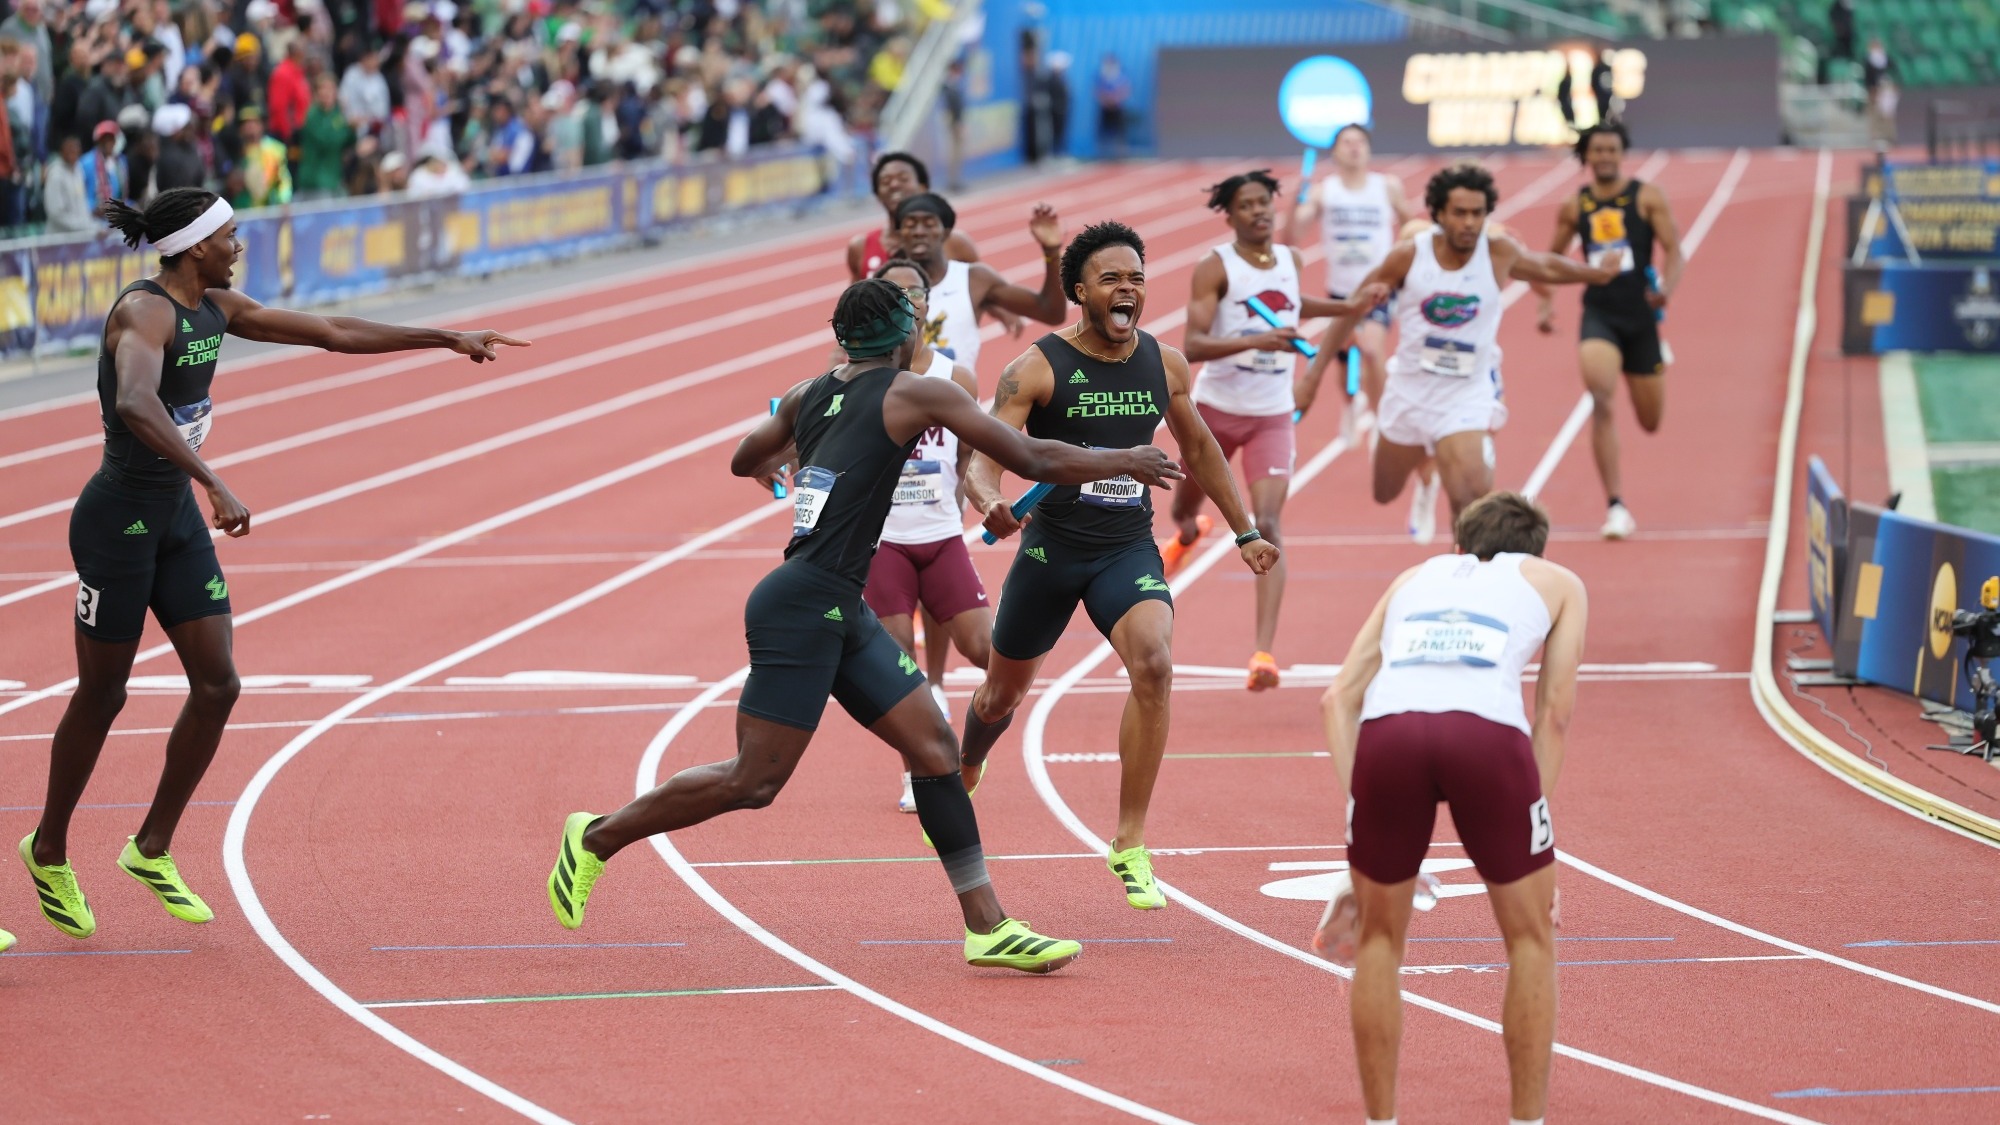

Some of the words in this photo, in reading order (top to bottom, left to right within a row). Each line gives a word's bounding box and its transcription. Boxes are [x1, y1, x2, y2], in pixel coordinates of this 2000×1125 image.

[187, 334, 221, 354] SOUTH
[1078, 390, 1153, 405] SOUTH
[1066, 403, 1160, 418] FLORIDA
[892, 488, 935, 501] OBINSON
[1092, 481, 1137, 496] MORONTA
[1025, 549, 1048, 564] adidas
[81, 586, 93, 621] 3
[823, 613, 844, 622] adidas
[1538, 803, 1550, 847] 5
